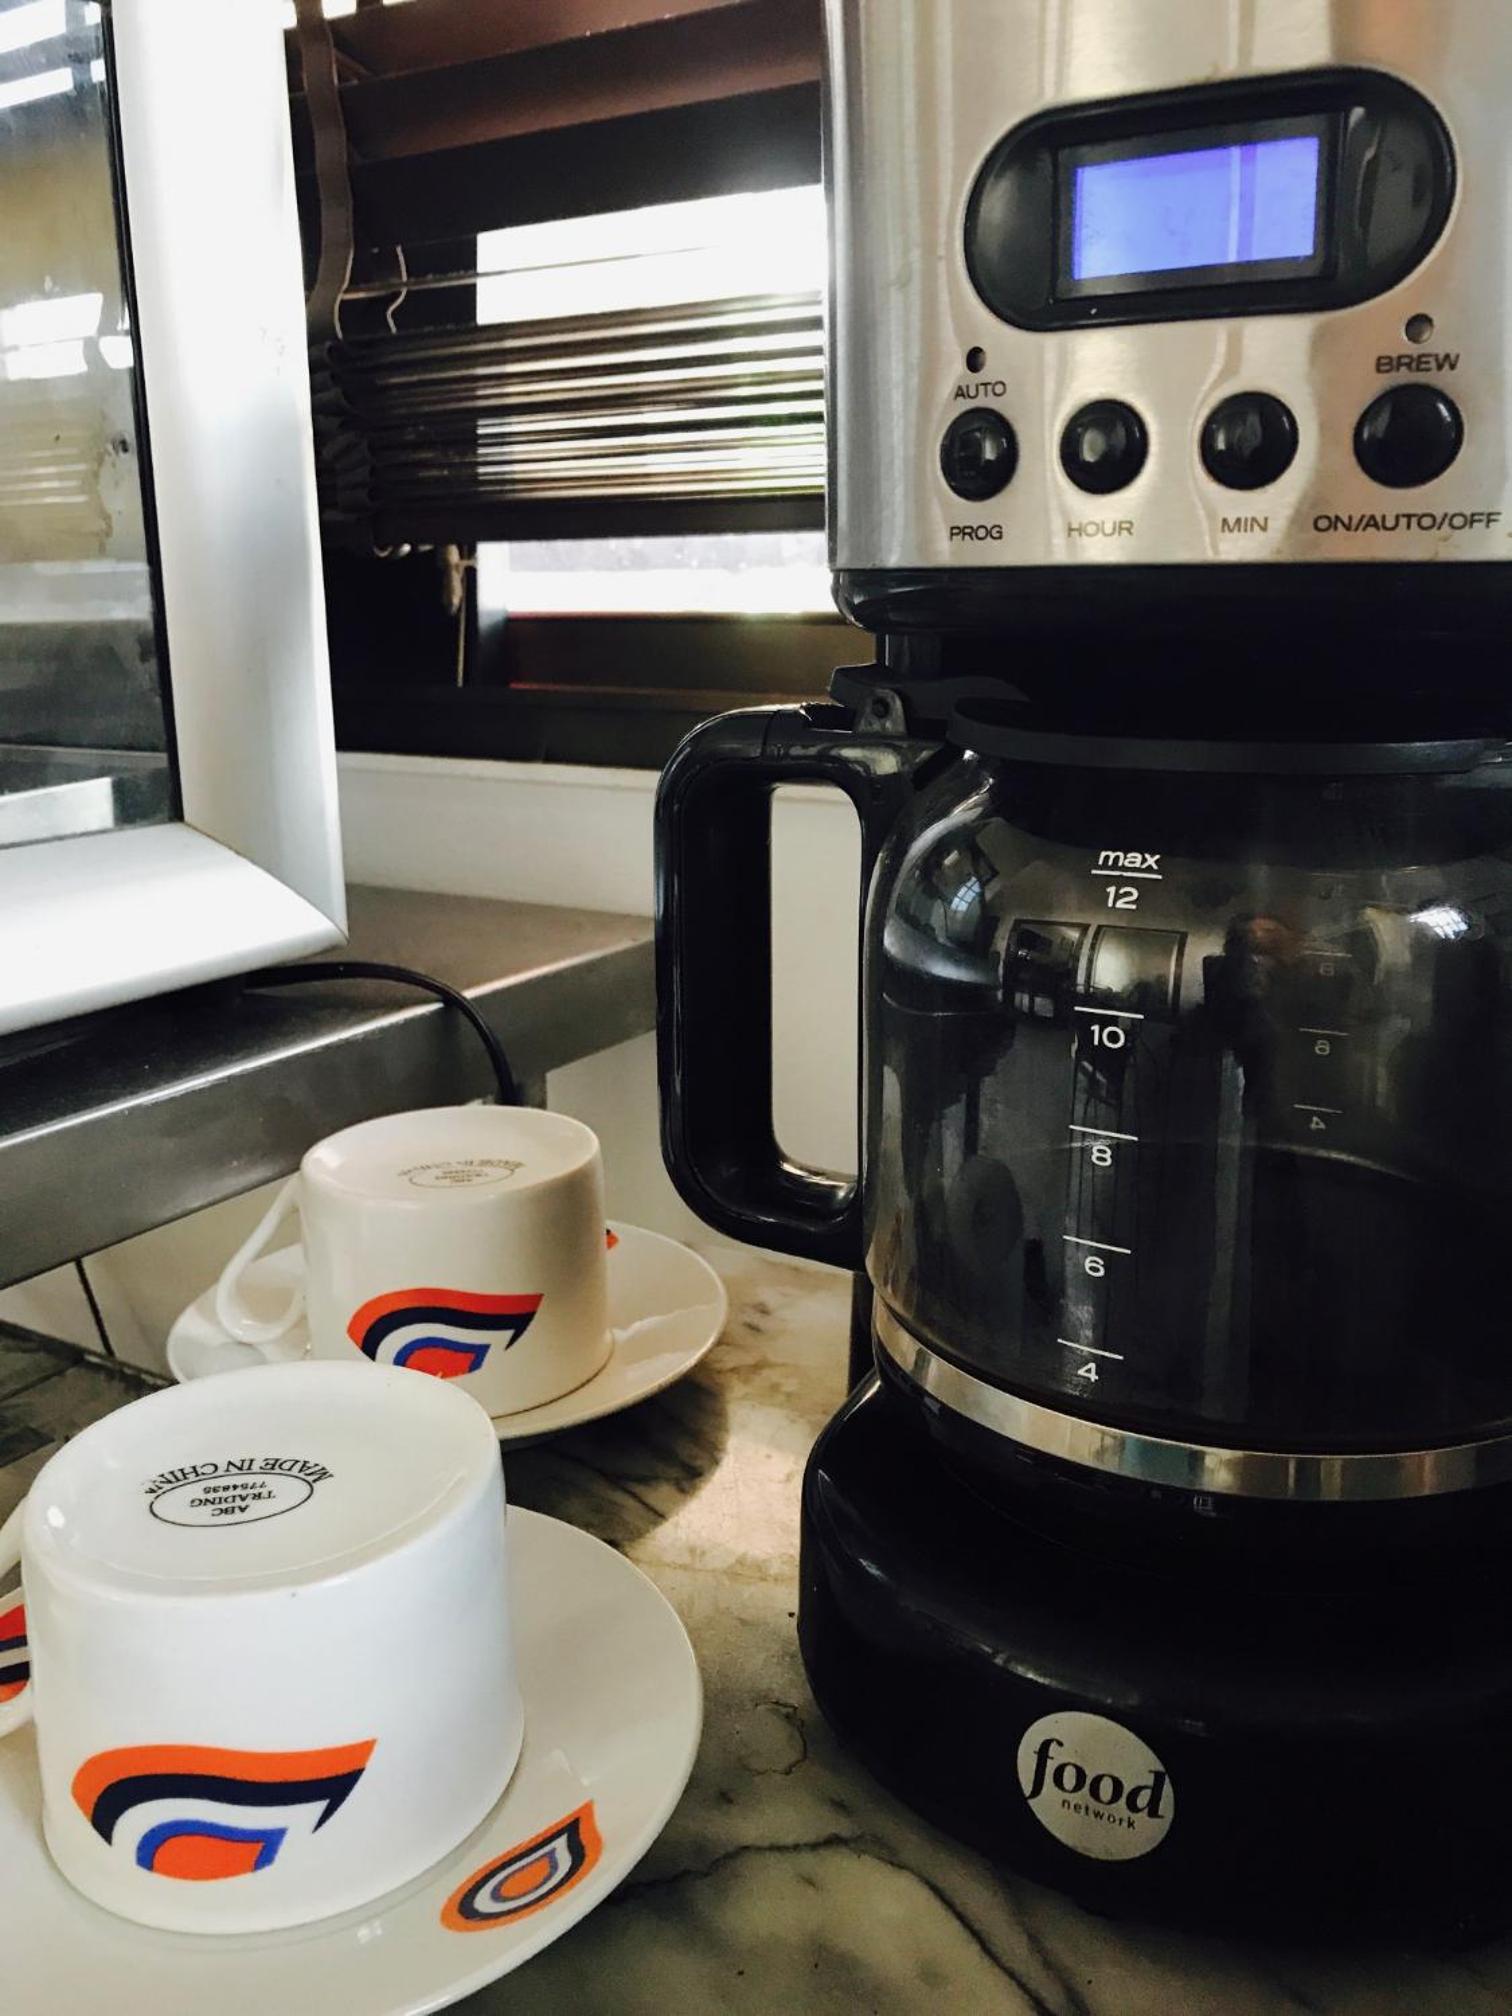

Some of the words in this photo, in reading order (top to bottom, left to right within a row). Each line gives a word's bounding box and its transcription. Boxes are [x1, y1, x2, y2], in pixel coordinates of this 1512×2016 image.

[1375, 352, 1460, 375] BREW
[953, 379, 1007, 400] AUTO
[949, 523, 1004, 541] PROG
[1066, 519, 1134, 539] HOUR
[1220, 515, 1269, 534] MIN
[1313, 511, 1501, 534] ON/AUTO/OFF
[1098, 849, 1161, 870] max
[1105, 885, 1139, 910] 12
[1090, 1024, 1125, 1049] 10
[1090, 1145, 1113, 1167] 8
[1084, 1256, 1105, 1278] 6
[1077, 1362, 1099, 1382] 4
[224, 1458, 256, 1473] IN
[259, 1457, 334, 1484] MADE
[189, 1490, 276, 1508] TRADING
[210, 1504, 250, 1517] ABC
[1025, 1737, 1167, 1820] food
[1061, 1798, 1136, 1830] network
